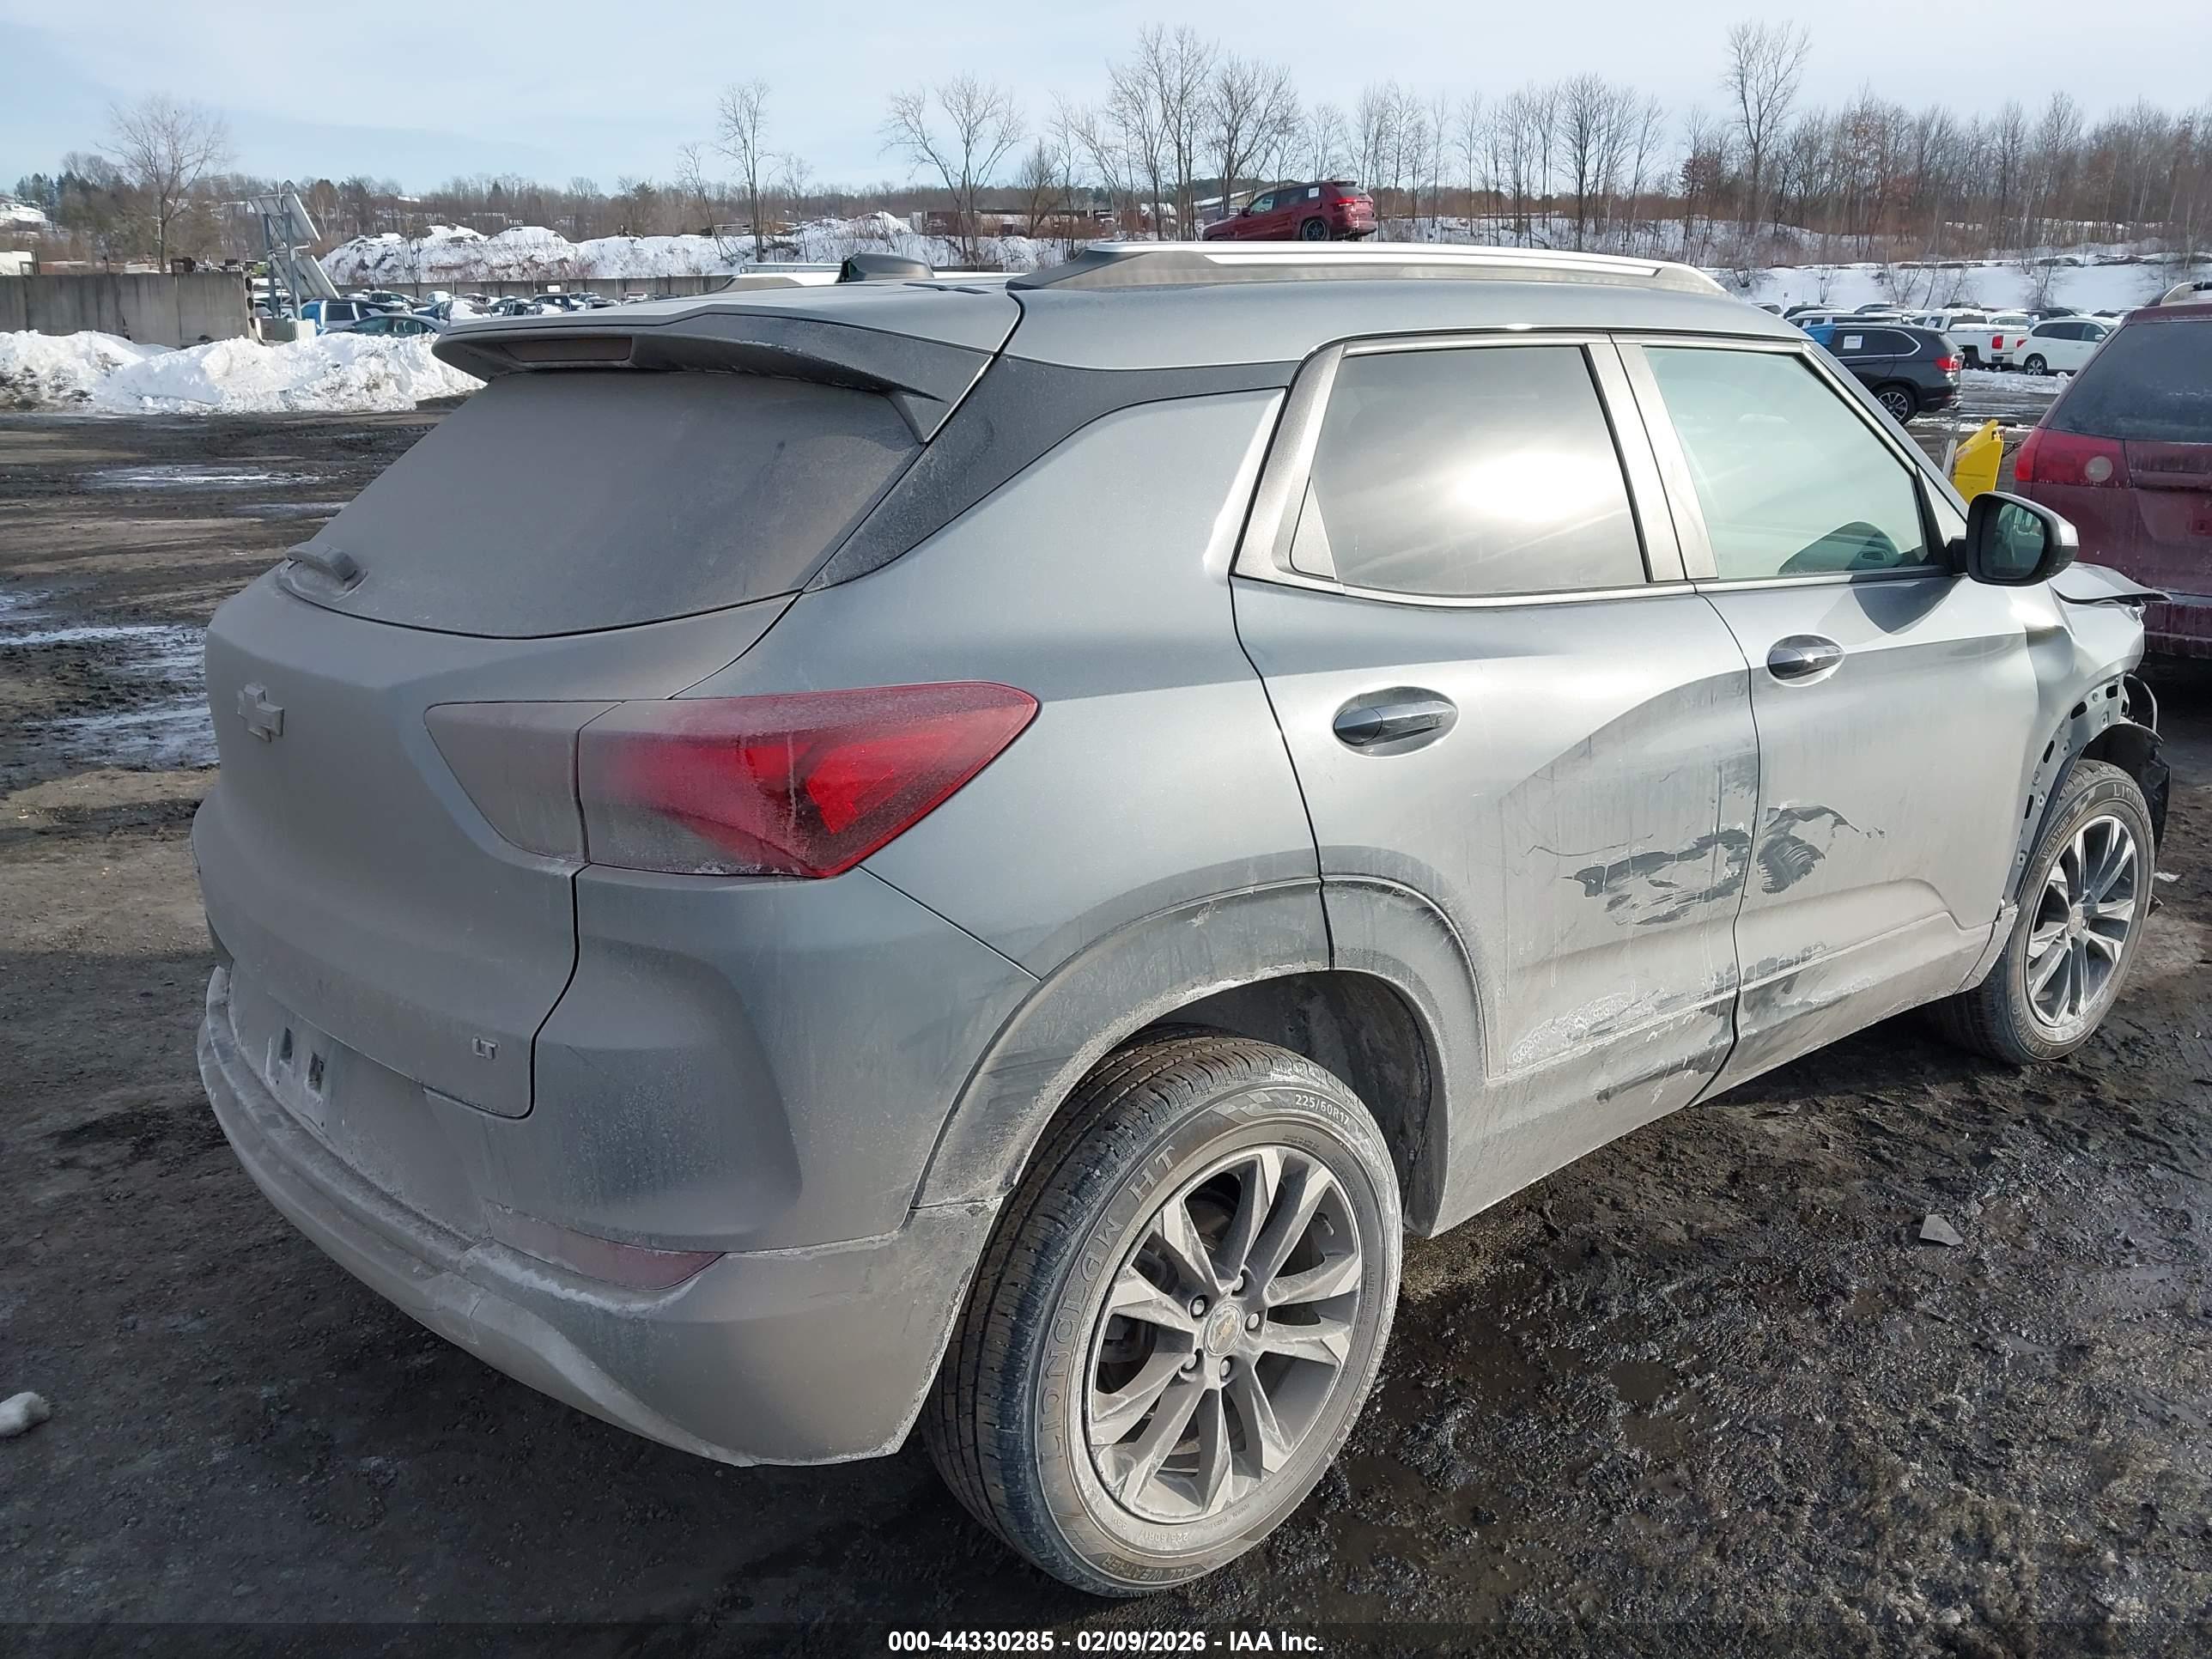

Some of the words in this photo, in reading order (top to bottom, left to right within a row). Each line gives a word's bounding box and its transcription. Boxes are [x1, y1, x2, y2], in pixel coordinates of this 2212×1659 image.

[2041, 816, 2071, 860] WEATHER
[472, 1037, 498, 1060] LT
[1294, 1093, 1350, 1126] 225/60R17
[1038, 1214, 1124, 1460] LIONCLAW
[1127, 1144, 1176, 1202] HT
[1101, 1554, 1165, 1581] WEATHER
[1167, 1566, 1195, 1577] ALL
